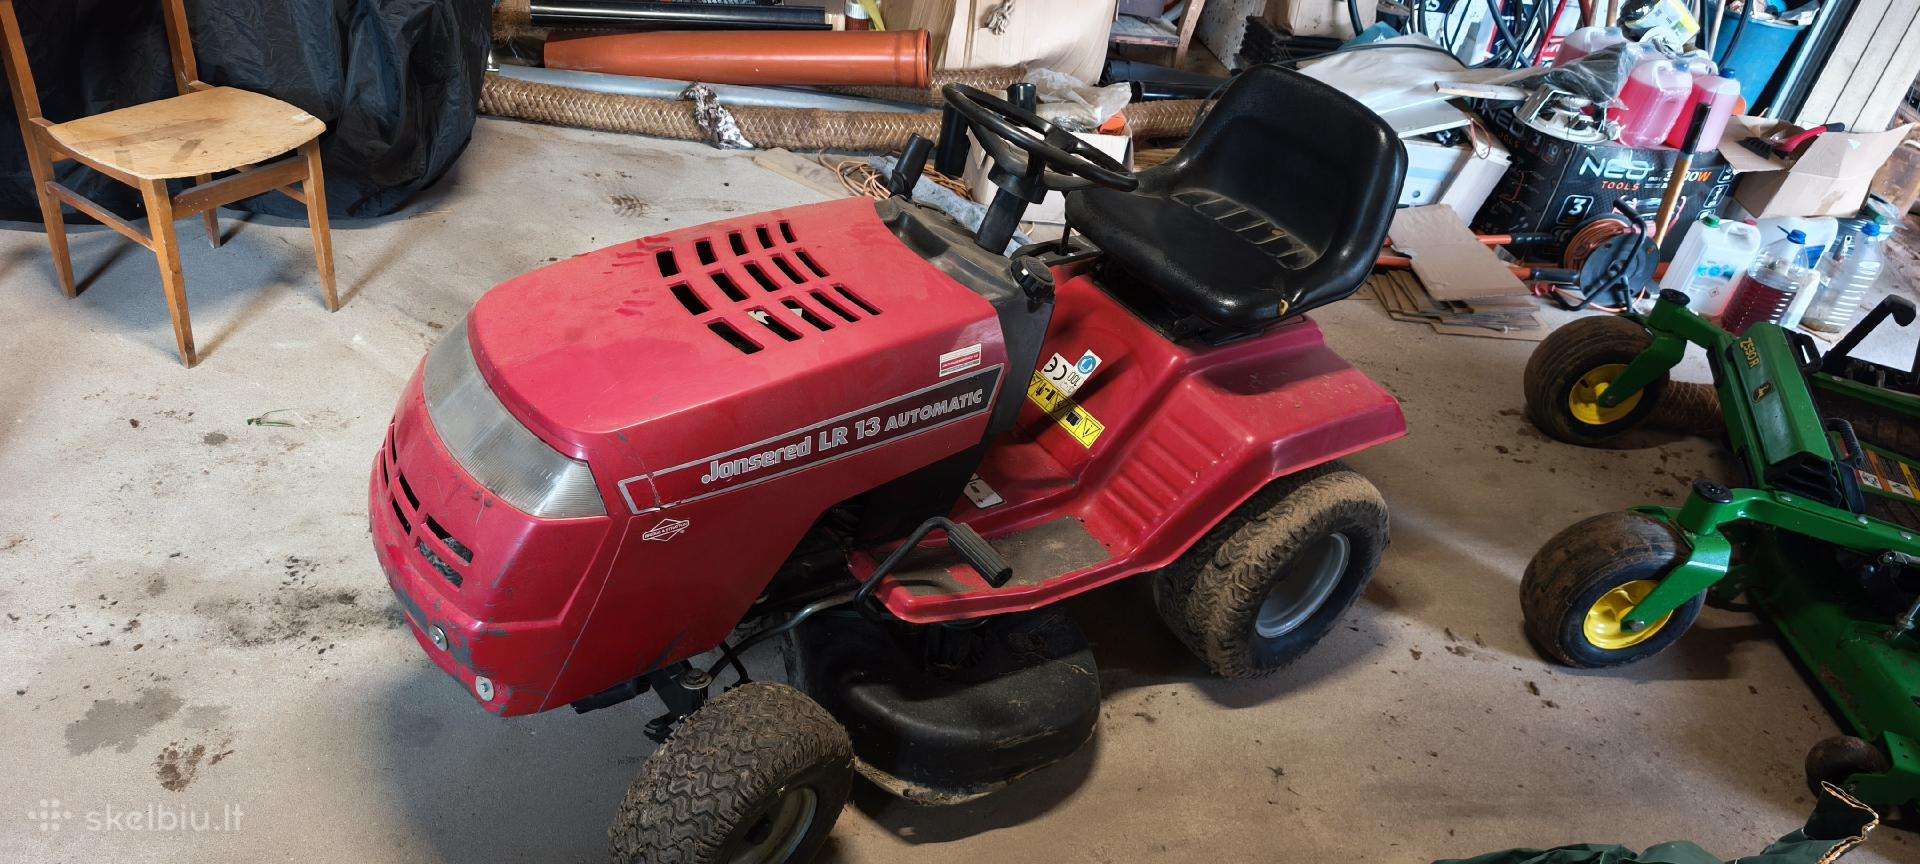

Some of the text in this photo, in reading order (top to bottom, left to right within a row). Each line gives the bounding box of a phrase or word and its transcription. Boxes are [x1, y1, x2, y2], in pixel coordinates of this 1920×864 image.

[1578, 156, 1650, 180] NEO
[1601, 180, 1639, 191] TOOLS
[1568, 198, 1588, 215] 3
[701, 388, 983, 484] Jonsered LR 13 AUTOMATIC
